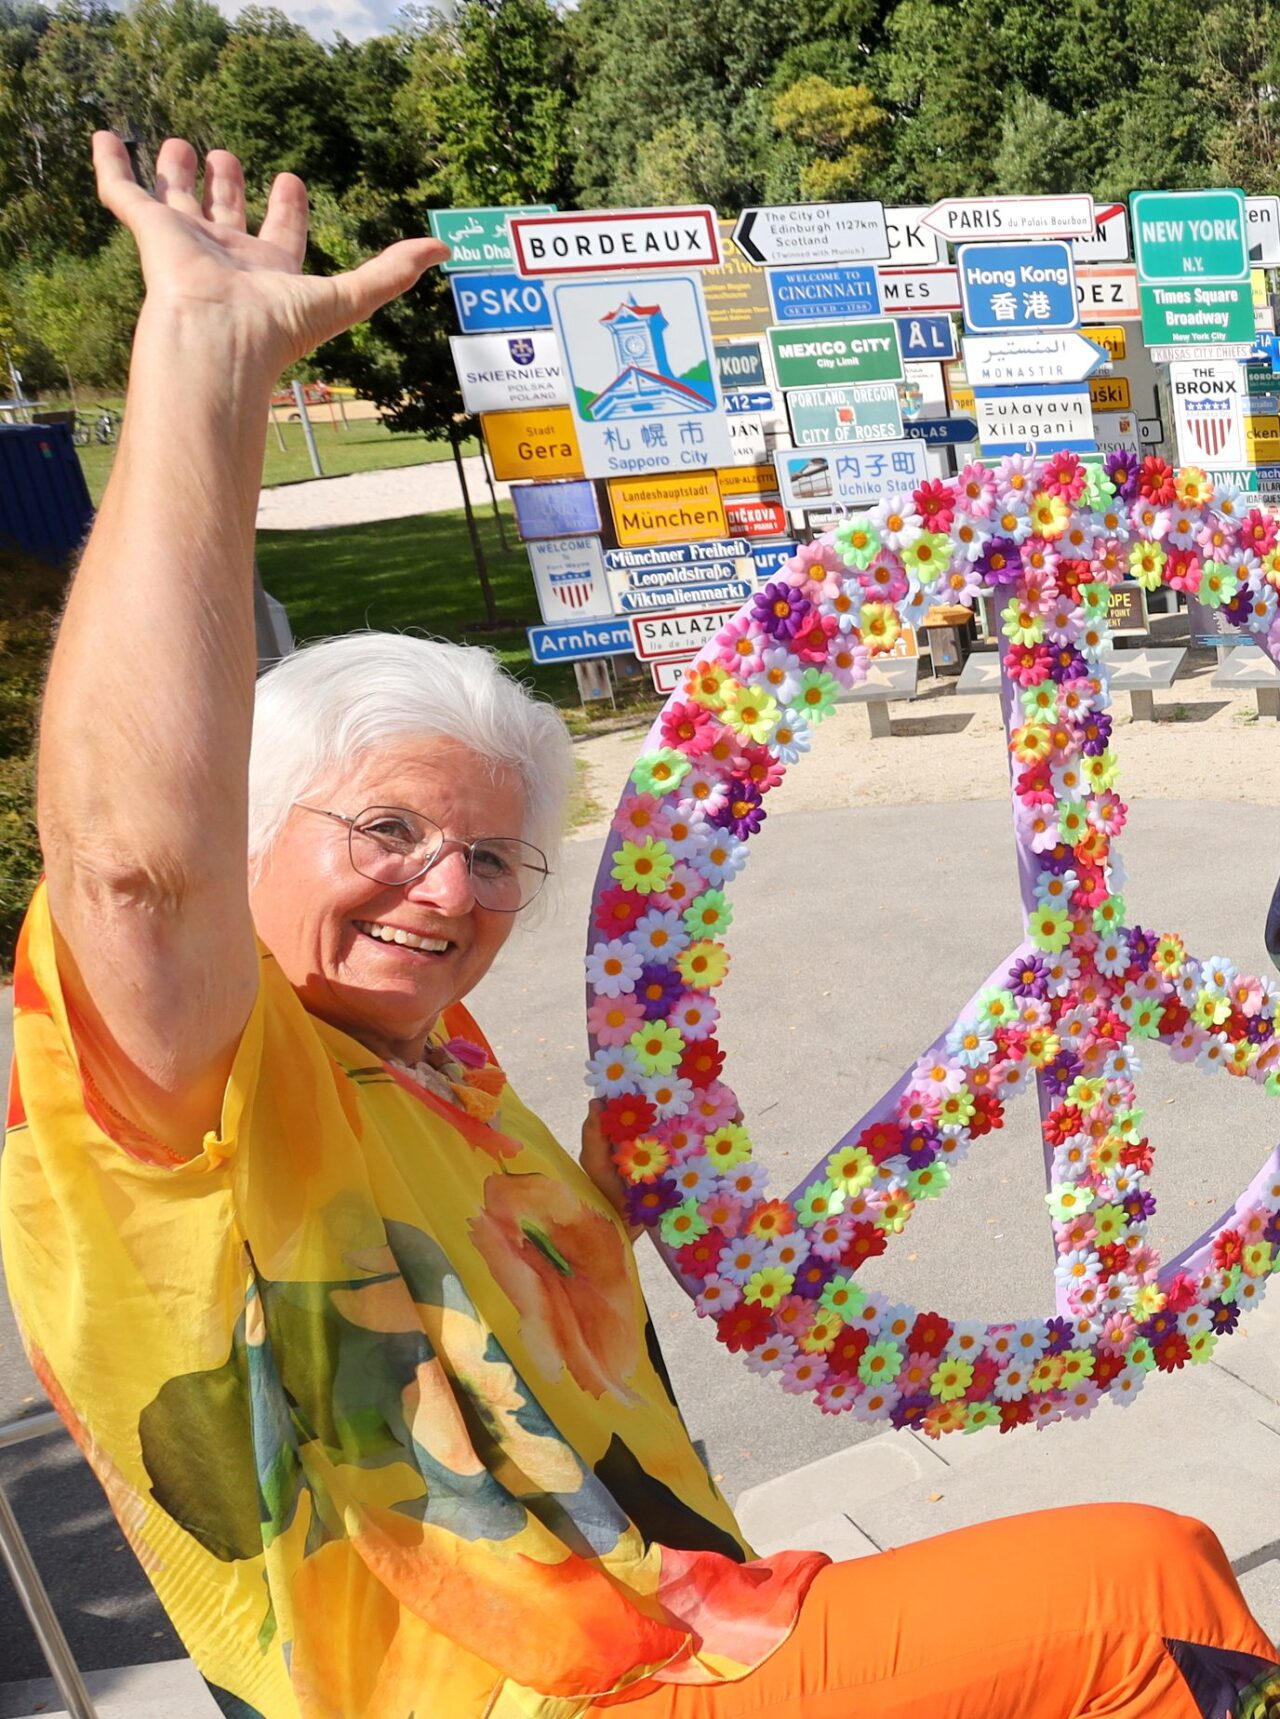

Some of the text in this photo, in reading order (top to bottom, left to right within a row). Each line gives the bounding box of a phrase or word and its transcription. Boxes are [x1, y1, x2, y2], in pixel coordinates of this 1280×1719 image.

[765, 210, 831, 222] The City Of
[947, 208, 1087, 229] PARIS du Palais Bourbon
[771, 219, 878, 236] Edinburgh 1127km
[1142, 218, 1240, 243] NEW YORK
[530, 229, 702, 259] BORDEAUX
[776, 236, 829, 247] Scotland
[453, 244, 483, 261] Abu
[1182, 256, 1204, 272] N.Y.
[786, 271, 860, 283] WELCOME TO
[966, 265, 1068, 288] Hong Kong
[778, 281, 872, 301] CINCINNATI
[1153, 287, 1238, 306] Times Square
[788, 305, 837, 316] SETTLED
[989, 291, 1052, 321] 香港
[1165, 310, 1229, 327] Broadway
[1172, 332, 1226, 342] New York City
[778, 337, 892, 359] MEXICO CITY
[1155, 346, 1247, 361] KANSAS CITY CHIEFS
[816, 356, 860, 369] City Limit
[982, 365, 1065, 378] MONASTIR
[1192, 368, 1215, 378] THE
[507, 383, 554, 393] POLSKA
[509, 391, 557, 402] POLAND
[1175, 380, 1237, 395] BRONX
[791, 386, 896, 409] PORTLAND, OREGON
[984, 400, 1083, 416] Ξυλαγανή
[526, 426, 555, 437] Stadt
[602, 420, 705, 452] 札幌市
[802, 422, 896, 445] CITY OF ROSES
[988, 419, 1075, 438] Xilagani
[518, 442, 573, 461] Gera
[608, 450, 709, 473] Sapporo City
[835, 450, 917, 479] 内子町
[621, 485, 709, 503] Landeshauptstadt
[839, 477, 882, 496] Uchiko
[621, 507, 720, 532] München
[536, 540, 593, 553] WELCOME
[610, 542, 746, 569] Münchner Freiheit
[632, 562, 732, 587] Leopoldstraße
[626, 584, 745, 607] Viktualienmarkt
[540, 629, 632, 654] Arnhem
[669, 640, 680, 649] de
